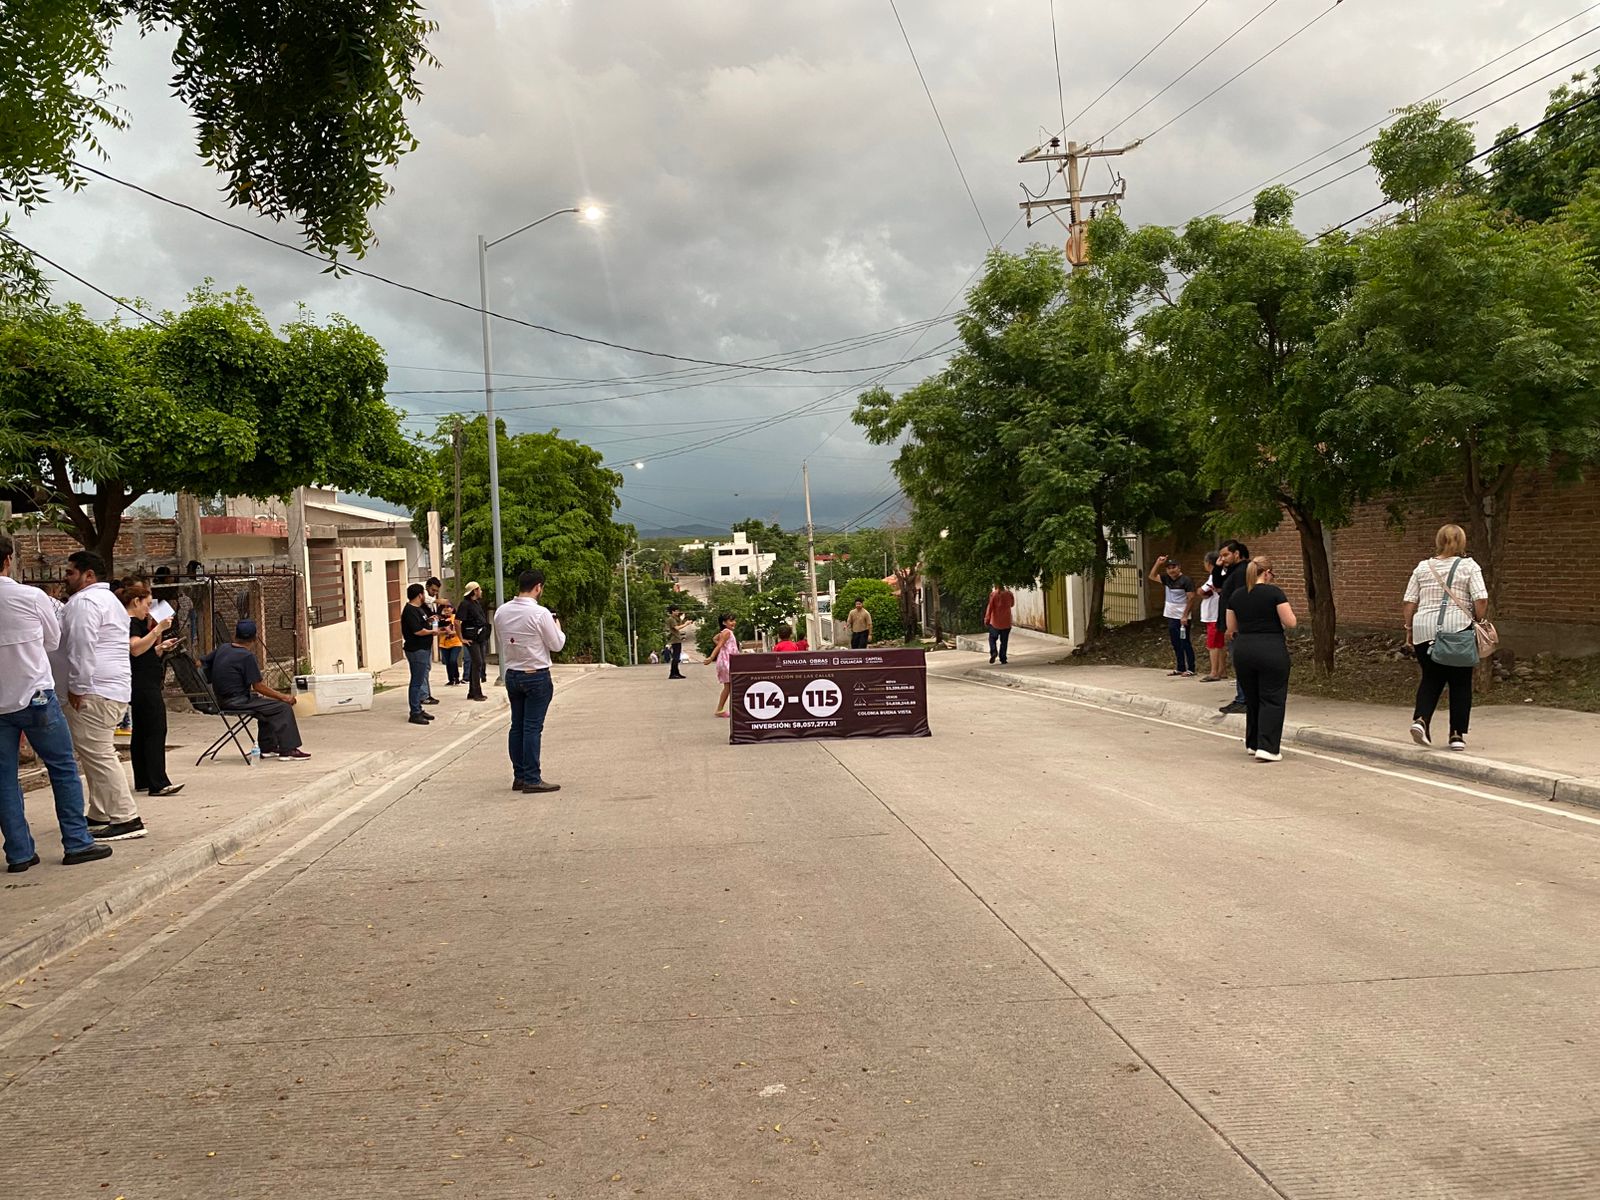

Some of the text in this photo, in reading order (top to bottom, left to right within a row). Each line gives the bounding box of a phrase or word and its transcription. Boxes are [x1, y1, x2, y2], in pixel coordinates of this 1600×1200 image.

[746, 692, 782, 710] 114
[805, 689, 839, 707] 115
[792, 720, 837, 729] $8,057,277.91
